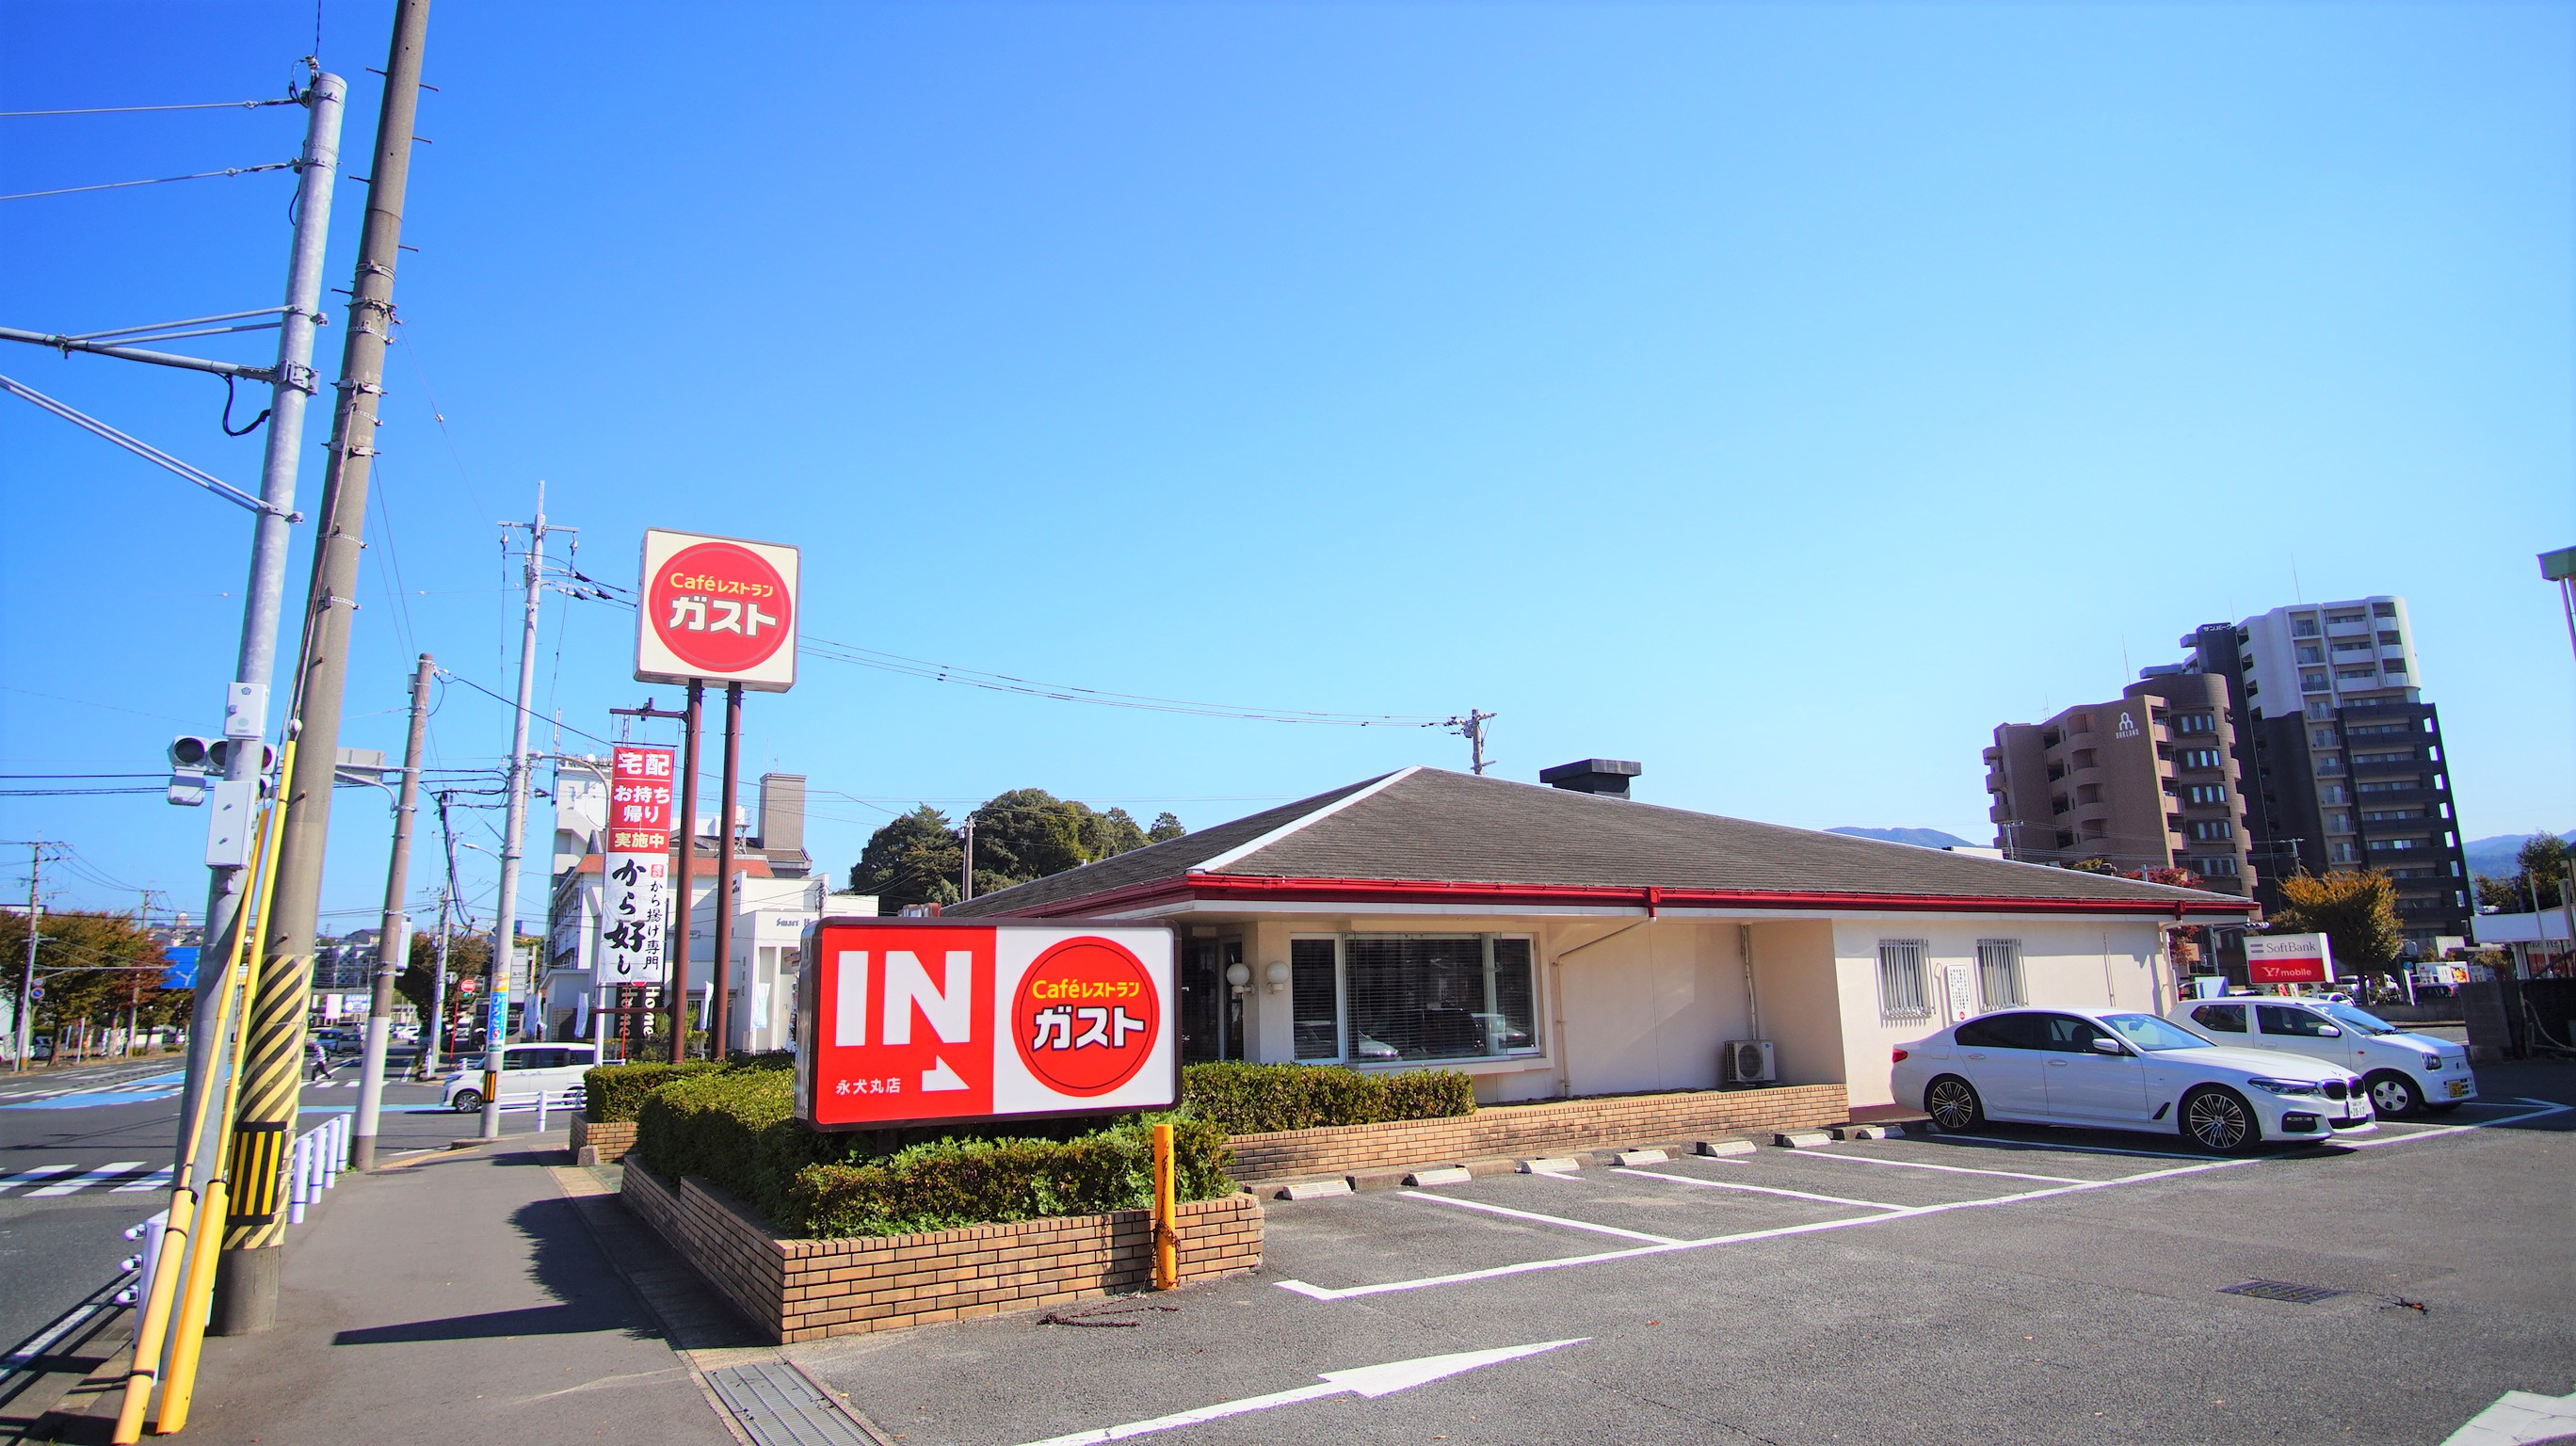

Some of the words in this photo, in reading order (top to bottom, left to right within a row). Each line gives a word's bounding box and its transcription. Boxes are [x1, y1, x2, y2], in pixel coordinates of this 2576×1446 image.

[669, 595, 777, 637] ガスト
[618, 752, 669, 777] 宅配
[614, 785, 670, 804] お持ち
[623, 805, 659, 824] 帰り
[615, 832, 665, 849] 実施中
[604, 859, 647, 975] から好し
[642, 880, 663, 971] から揚げ専門
[2266, 941, 2316, 954] SoftBank
[835, 950, 973, 1047] IN
[1032, 1004, 1146, 1052] ガスト
[835, 1077, 901, 1095] 永犬丸店
